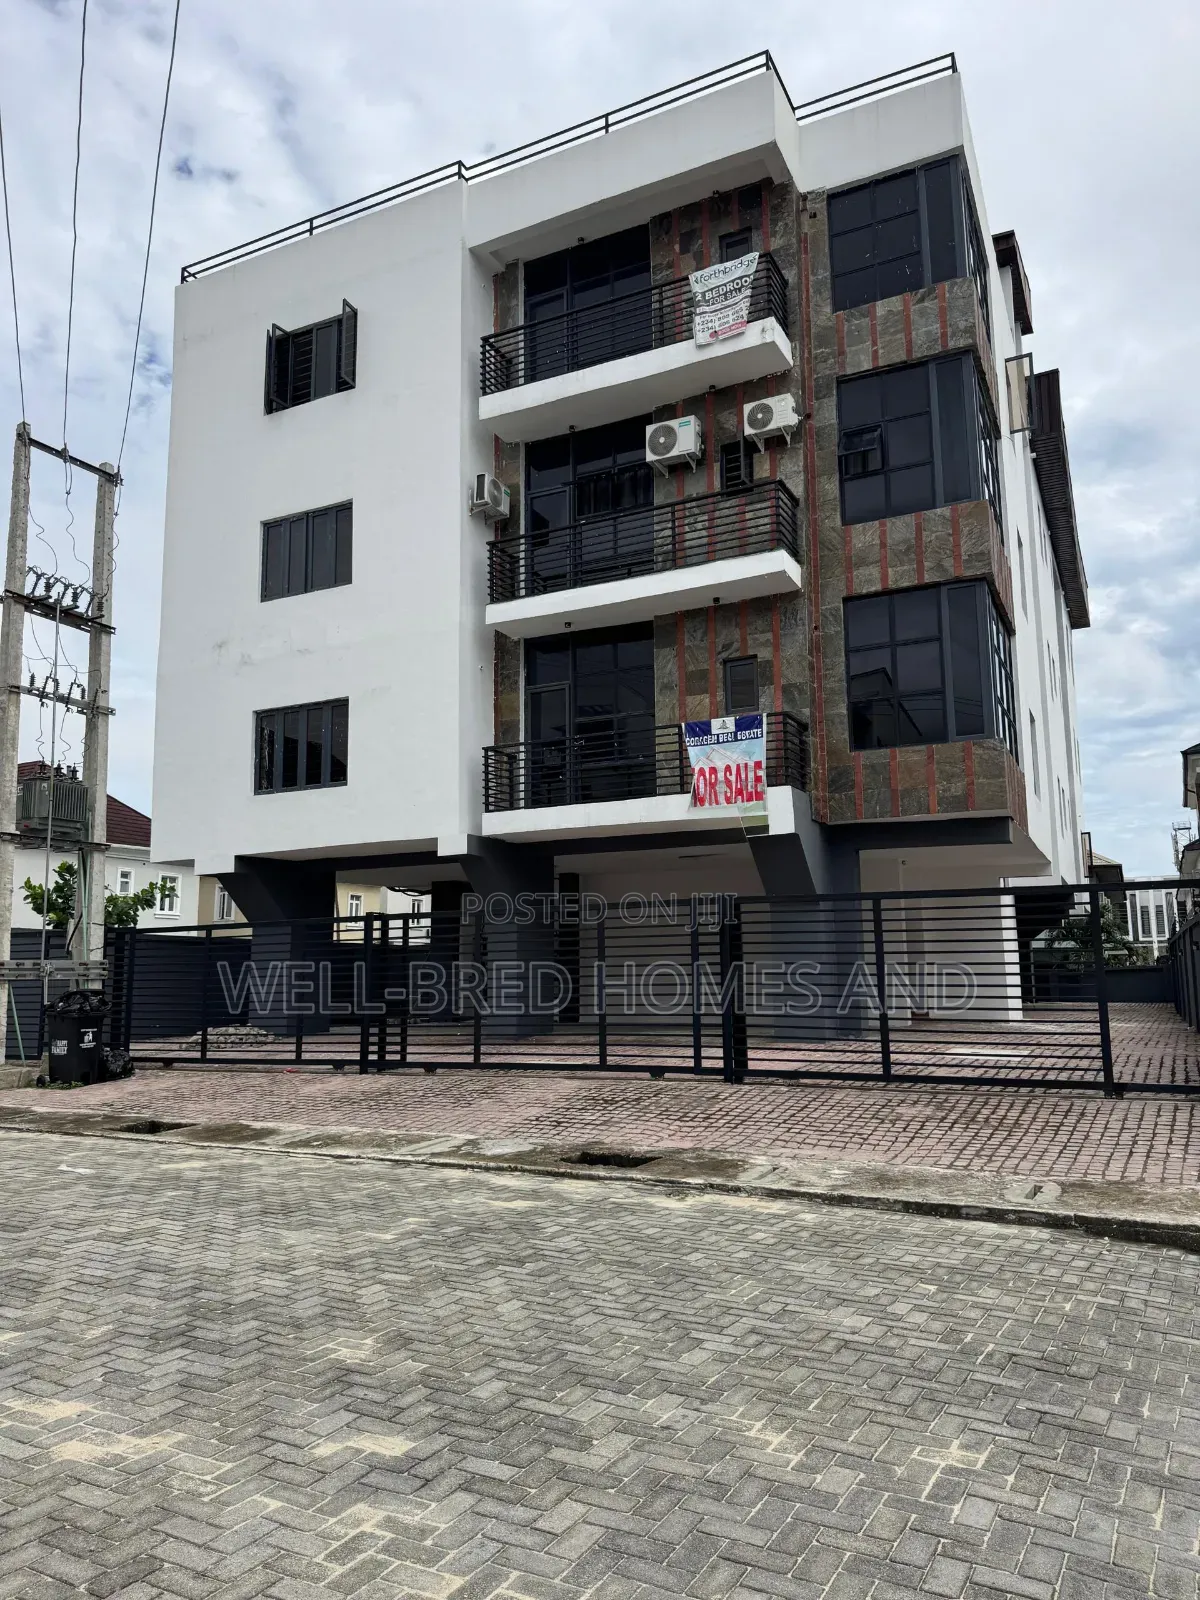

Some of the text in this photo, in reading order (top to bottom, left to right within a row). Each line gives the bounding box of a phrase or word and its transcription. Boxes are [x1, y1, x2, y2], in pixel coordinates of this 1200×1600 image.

[696, 292, 702, 301] 2
[709, 295, 725, 306] FOR
[724, 760, 764, 805] SALE
